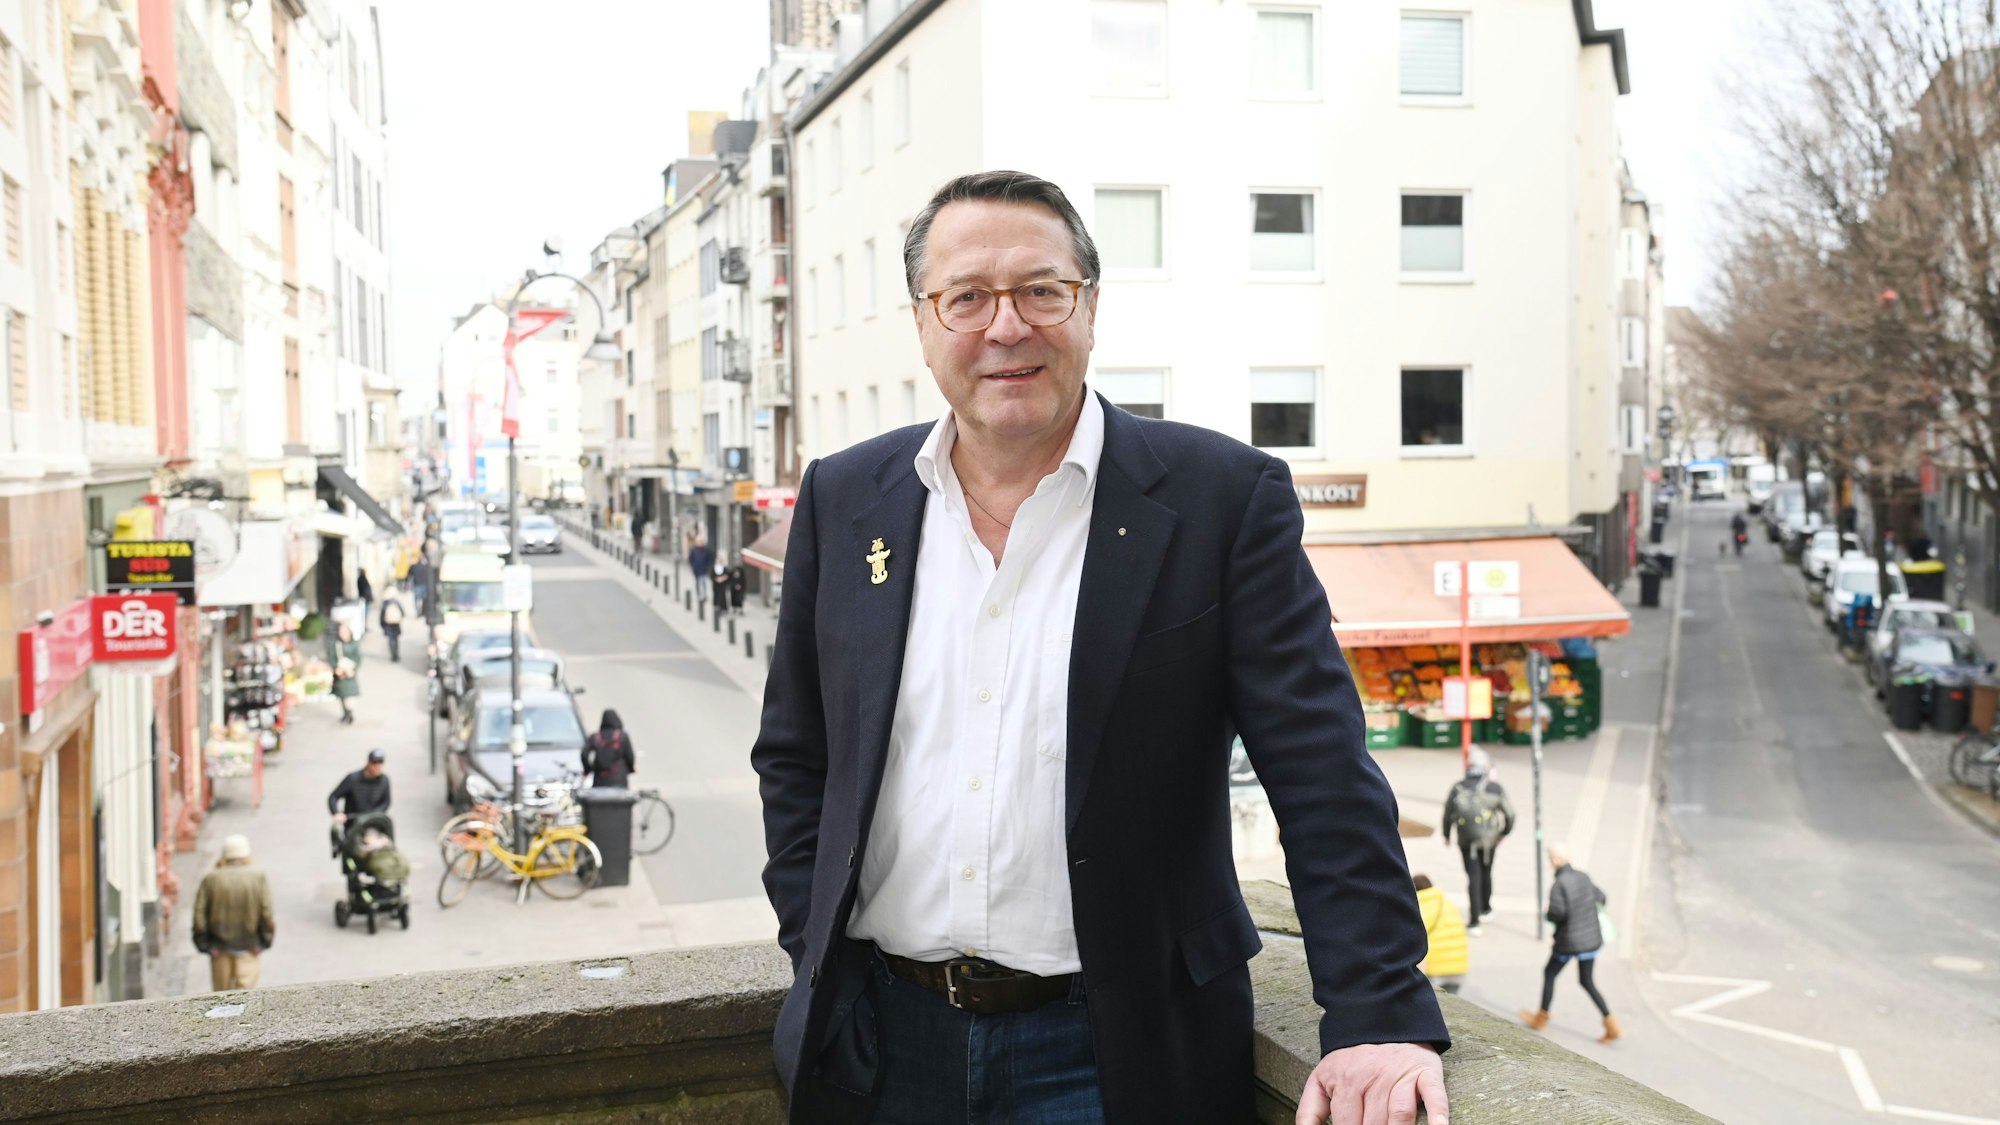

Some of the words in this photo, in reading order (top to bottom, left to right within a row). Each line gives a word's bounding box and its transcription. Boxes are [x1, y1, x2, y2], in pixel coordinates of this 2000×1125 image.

[1297, 484, 1361, 502] NKOST
[106, 543, 193, 558] TURISTA
[102, 610, 168, 638] DER
[106, 638, 168, 652] Touristik
